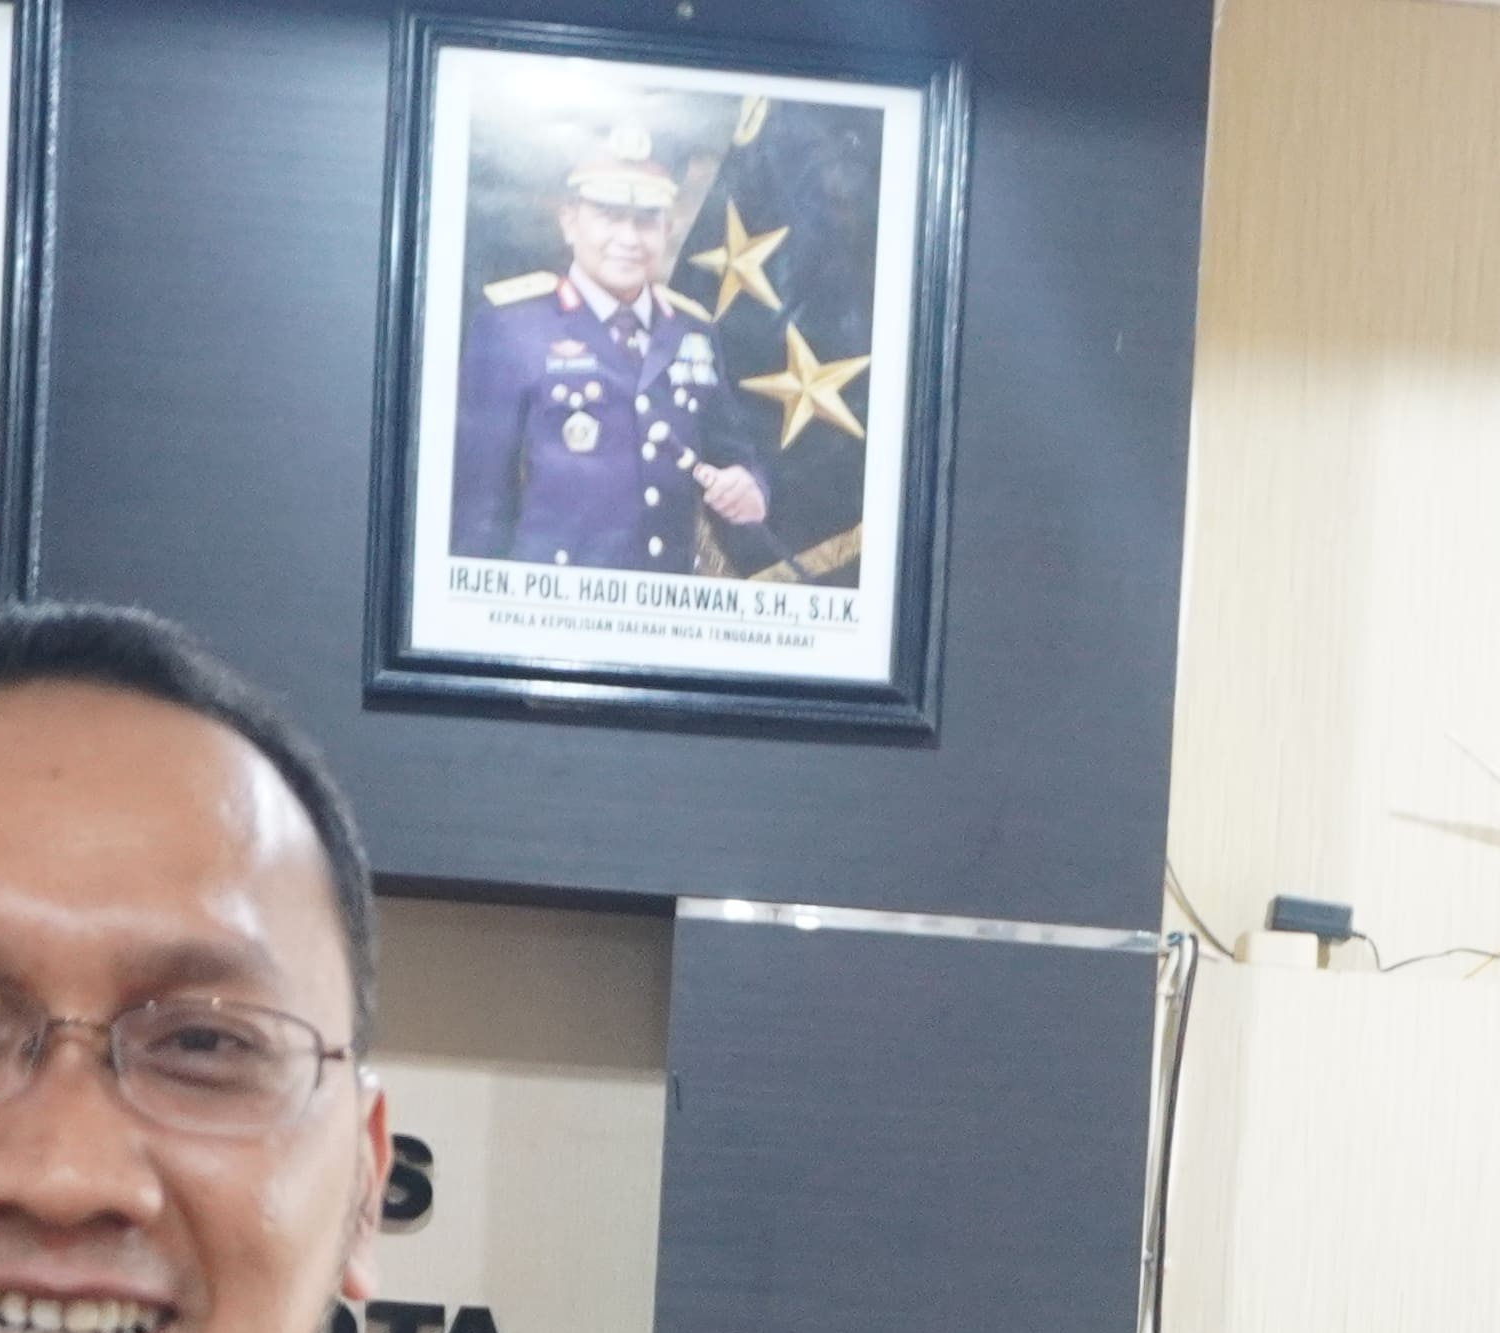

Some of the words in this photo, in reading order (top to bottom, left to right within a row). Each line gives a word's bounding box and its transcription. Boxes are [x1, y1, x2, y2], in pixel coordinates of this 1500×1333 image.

[449, 565, 516, 596] IRJEN.
[524, 572, 570, 601] POL.
[578, 575, 627, 605] HADI
[636, 580, 746, 622] GUNAWAN,
[808, 594, 861, 624] S.I.K.
